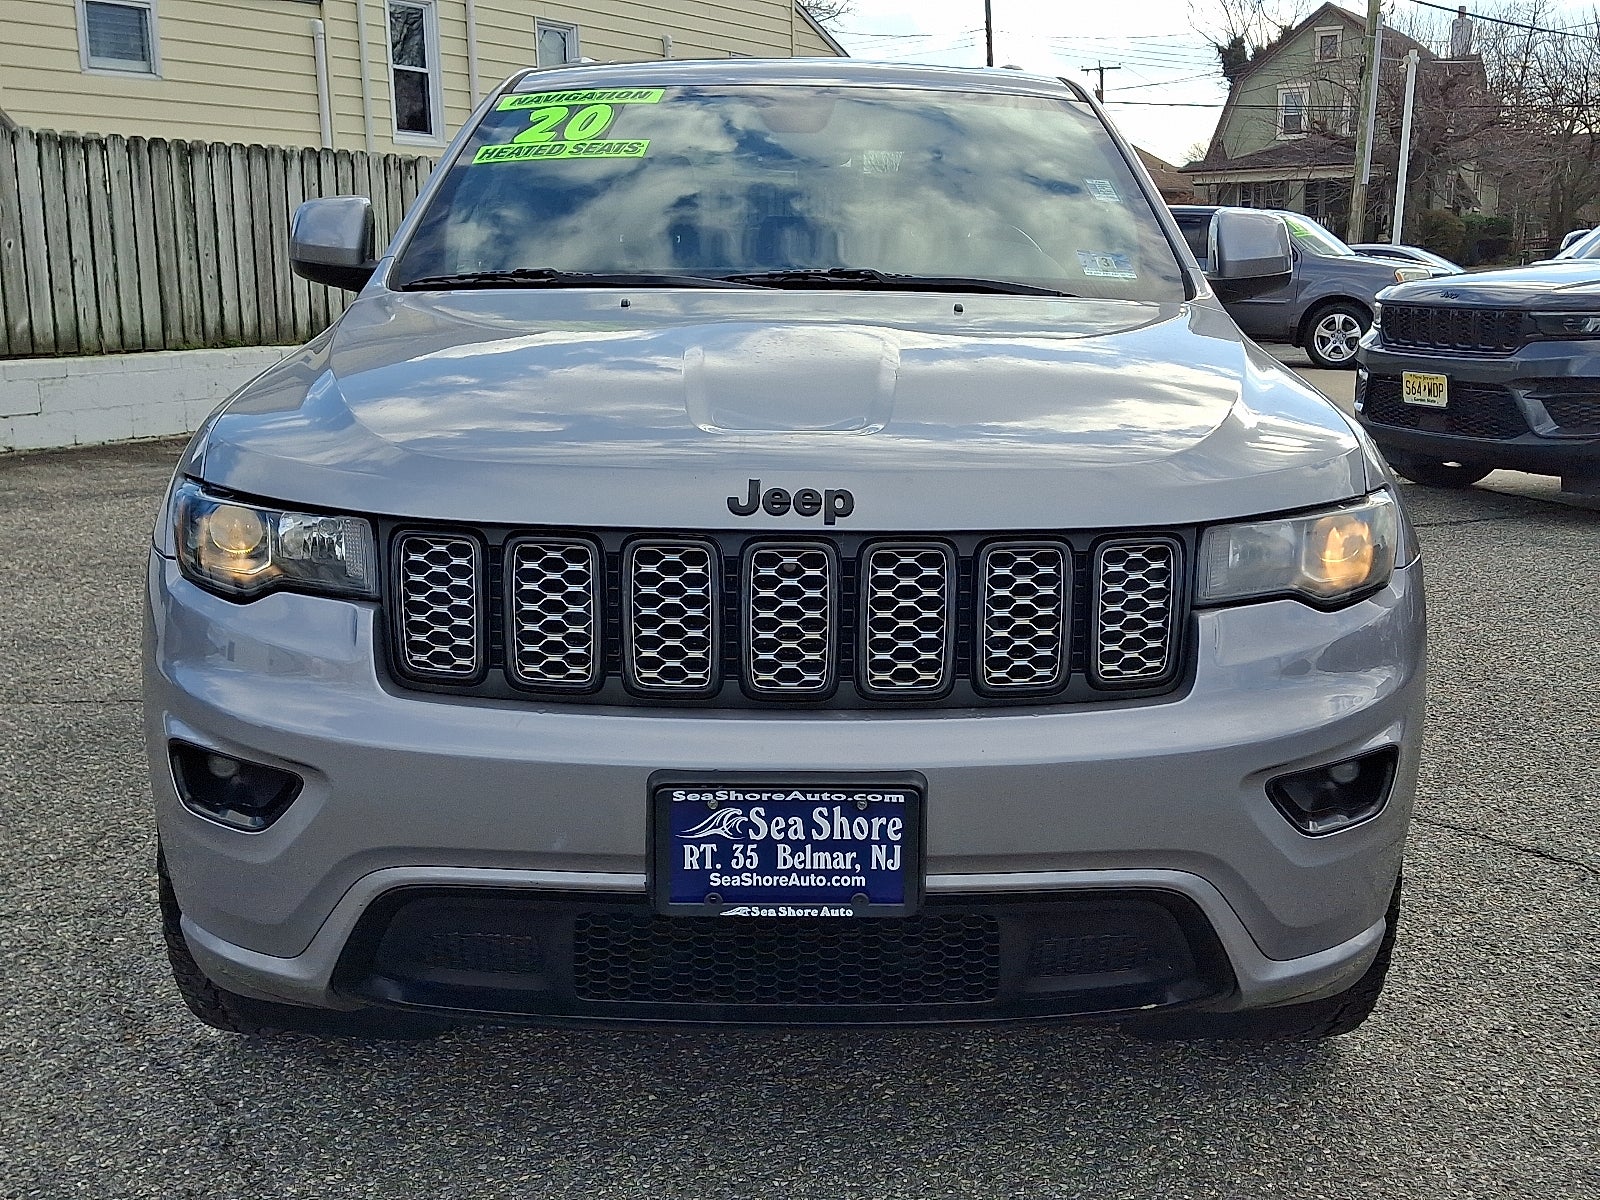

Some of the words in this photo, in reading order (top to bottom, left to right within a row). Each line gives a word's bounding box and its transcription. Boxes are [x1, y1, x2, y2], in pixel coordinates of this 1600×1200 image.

[509, 90, 651, 106] NAVIGATION
[513, 104, 614, 144] 20
[478, 143, 567, 160] HEATED
[567, 141, 645, 156] SEATS
[727, 479, 855, 526] Jeep
[672, 790, 905, 803] SeaShoreAuto.com
[748, 806, 806, 841] Sea
[811, 805, 903, 841] Shore
[683, 844, 722, 870] RT.
[730, 844, 759, 870] 35
[776, 844, 862, 873] Belmar,
[870, 844, 902, 870] NJ
[709, 872, 866, 887] SeaShoreAuto.com
[750, 906, 777, 917] Sea
[778, 906, 819, 917] Shore
[820, 906, 853, 917] Auto
